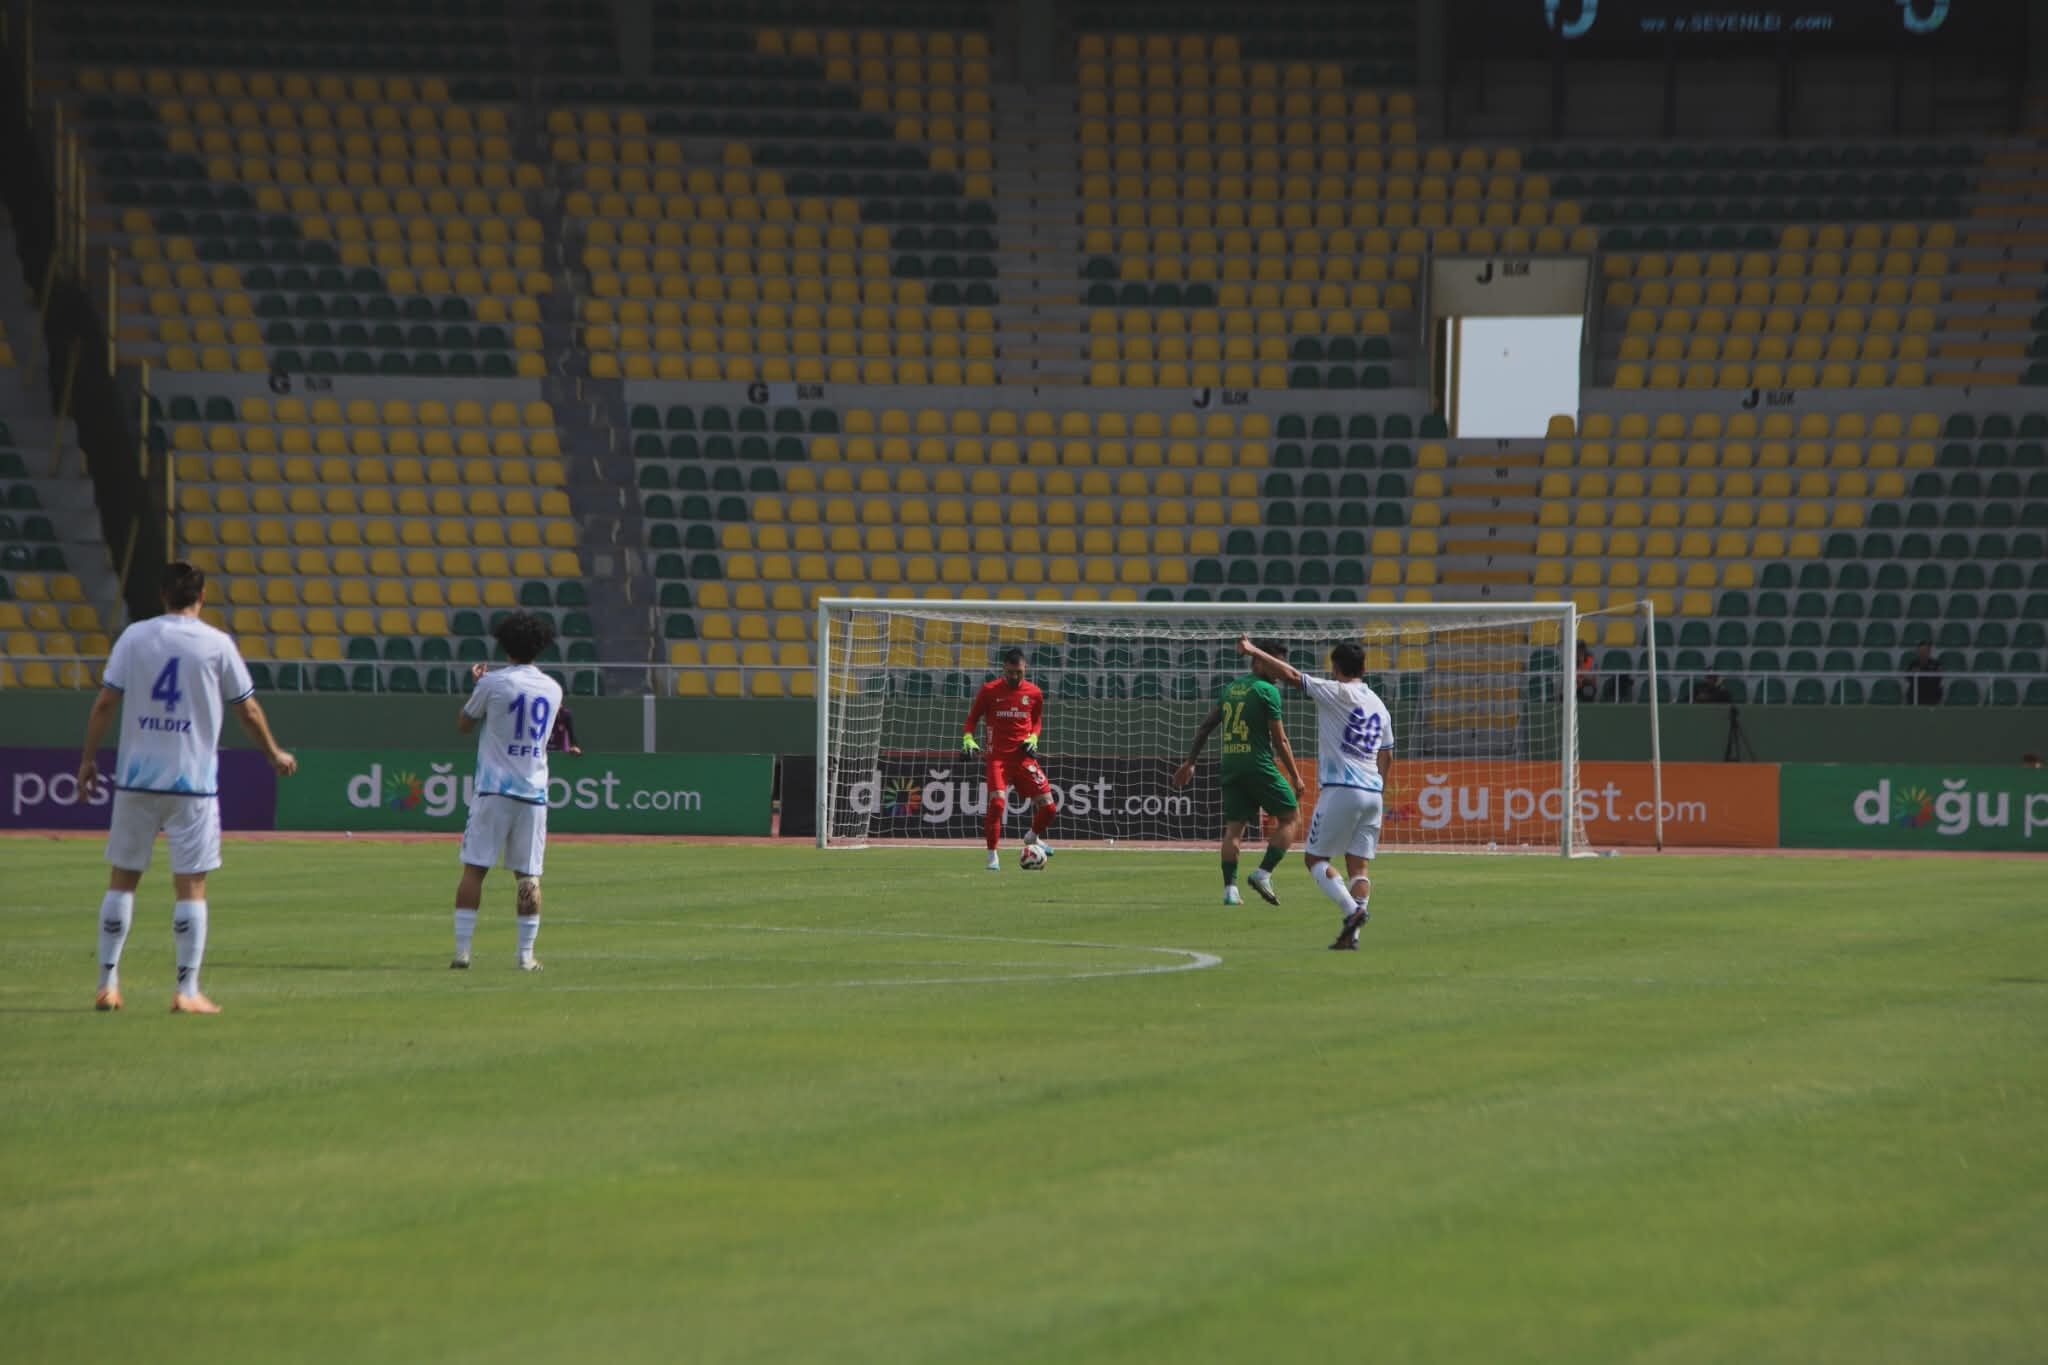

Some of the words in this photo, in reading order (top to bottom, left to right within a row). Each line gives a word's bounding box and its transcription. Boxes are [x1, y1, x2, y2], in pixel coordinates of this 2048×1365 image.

[1476, 261, 1493, 284] J
[268, 374, 291, 396] G
[747, 383, 769, 404] G
[1191, 387, 1211, 408] J
[1741, 388, 1759, 410] J
[151, 657, 182, 712] 4
[138, 716, 192, 733] YILDIZ
[509, 693, 550, 741] 19
[13, 772, 116, 816] pos
